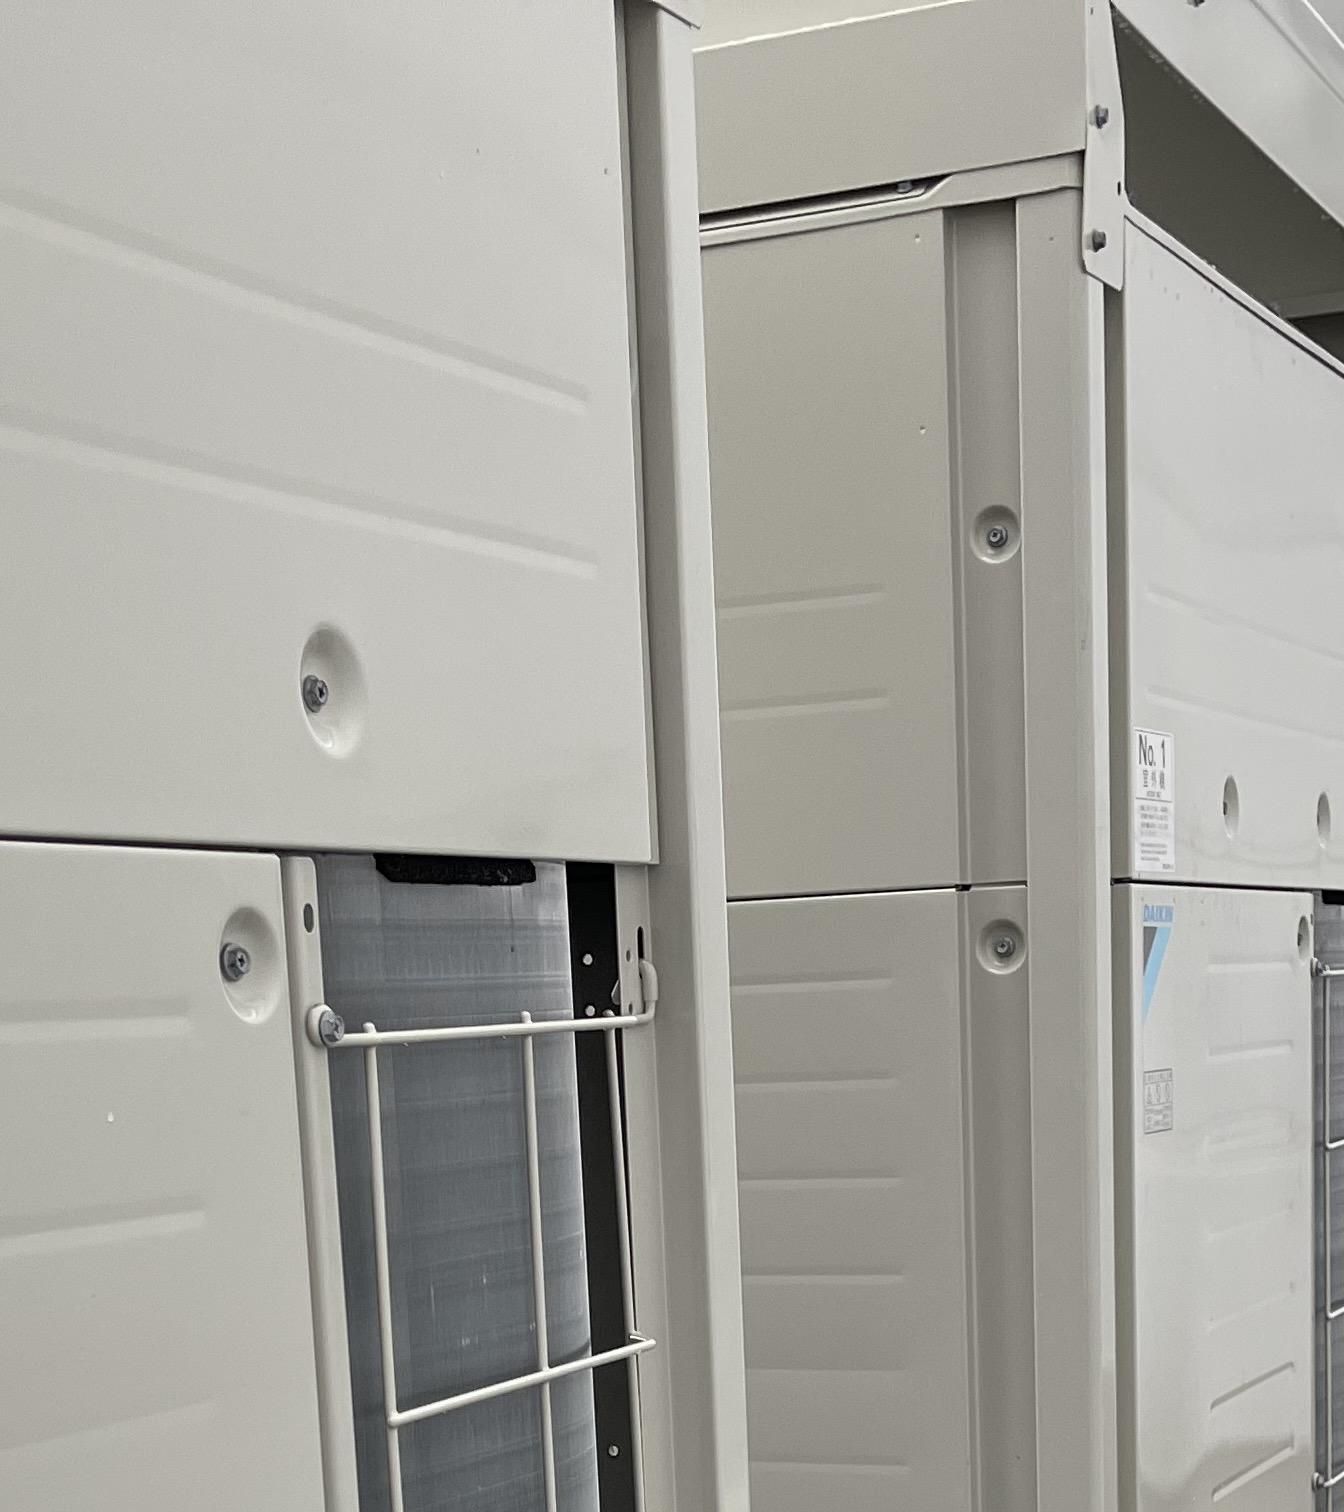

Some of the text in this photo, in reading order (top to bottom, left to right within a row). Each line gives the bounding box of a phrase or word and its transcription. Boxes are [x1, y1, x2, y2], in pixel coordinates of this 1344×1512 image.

[1138, 734, 1166, 769] No. 1
[1143, 904, 1174, 923] DAIKIN
